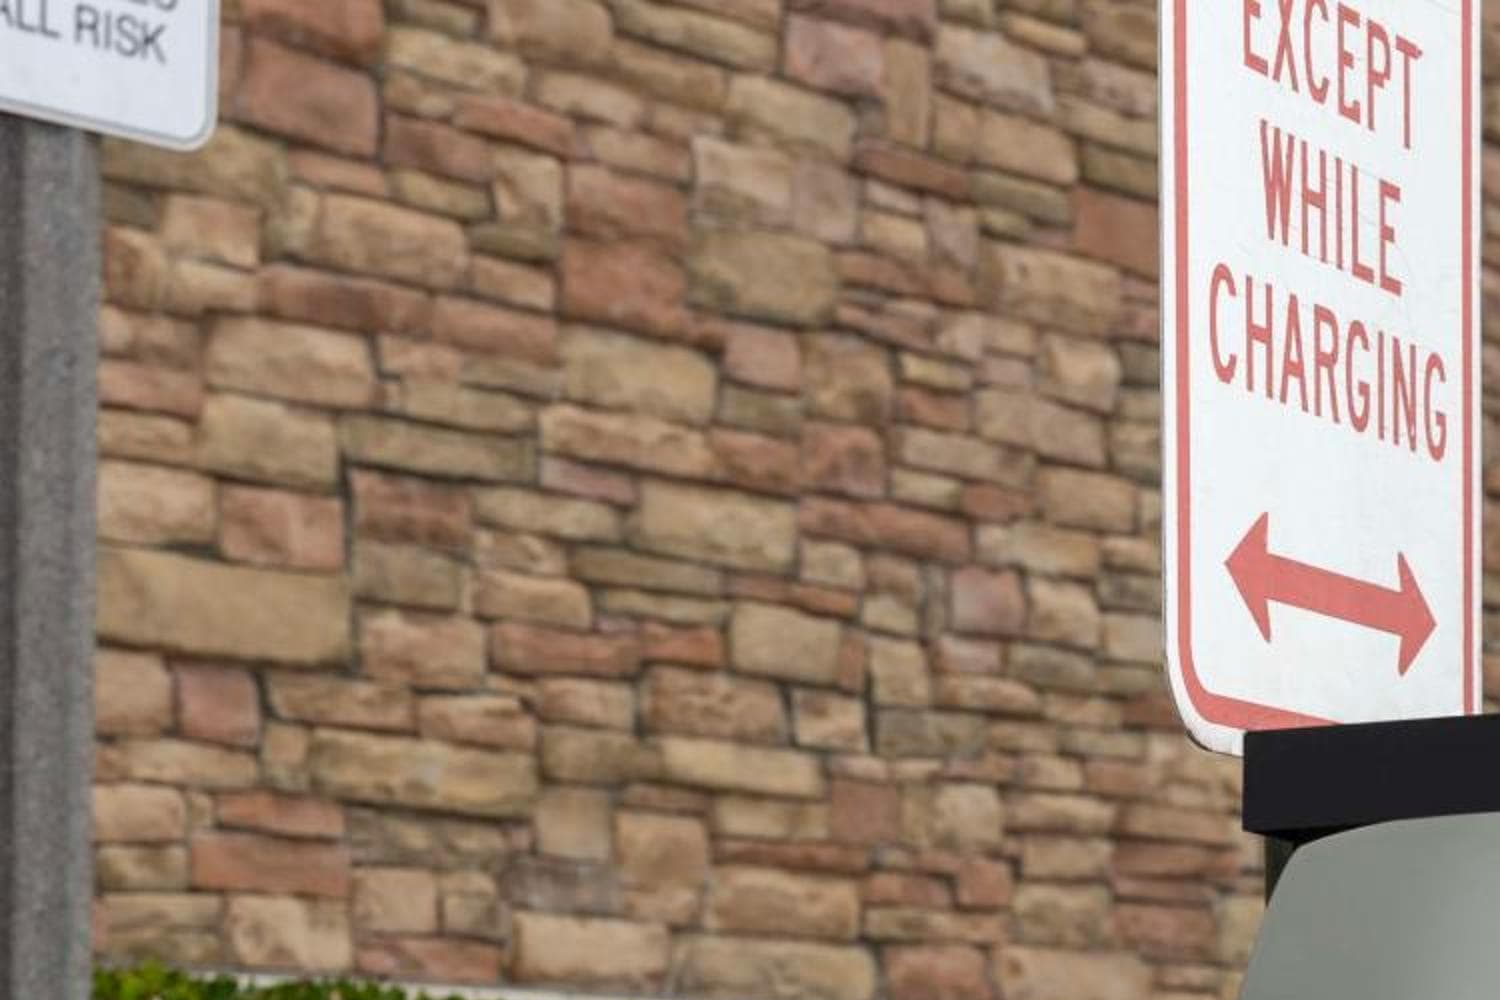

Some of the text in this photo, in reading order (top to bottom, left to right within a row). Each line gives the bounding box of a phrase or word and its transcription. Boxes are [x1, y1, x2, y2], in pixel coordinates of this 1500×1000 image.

[75, 4, 166, 64] RISK
[1244, 0, 1423, 150] EXCEPT
[1260, 118, 1403, 297] WHILE
[1209, 263, 1447, 461] CHARGING
